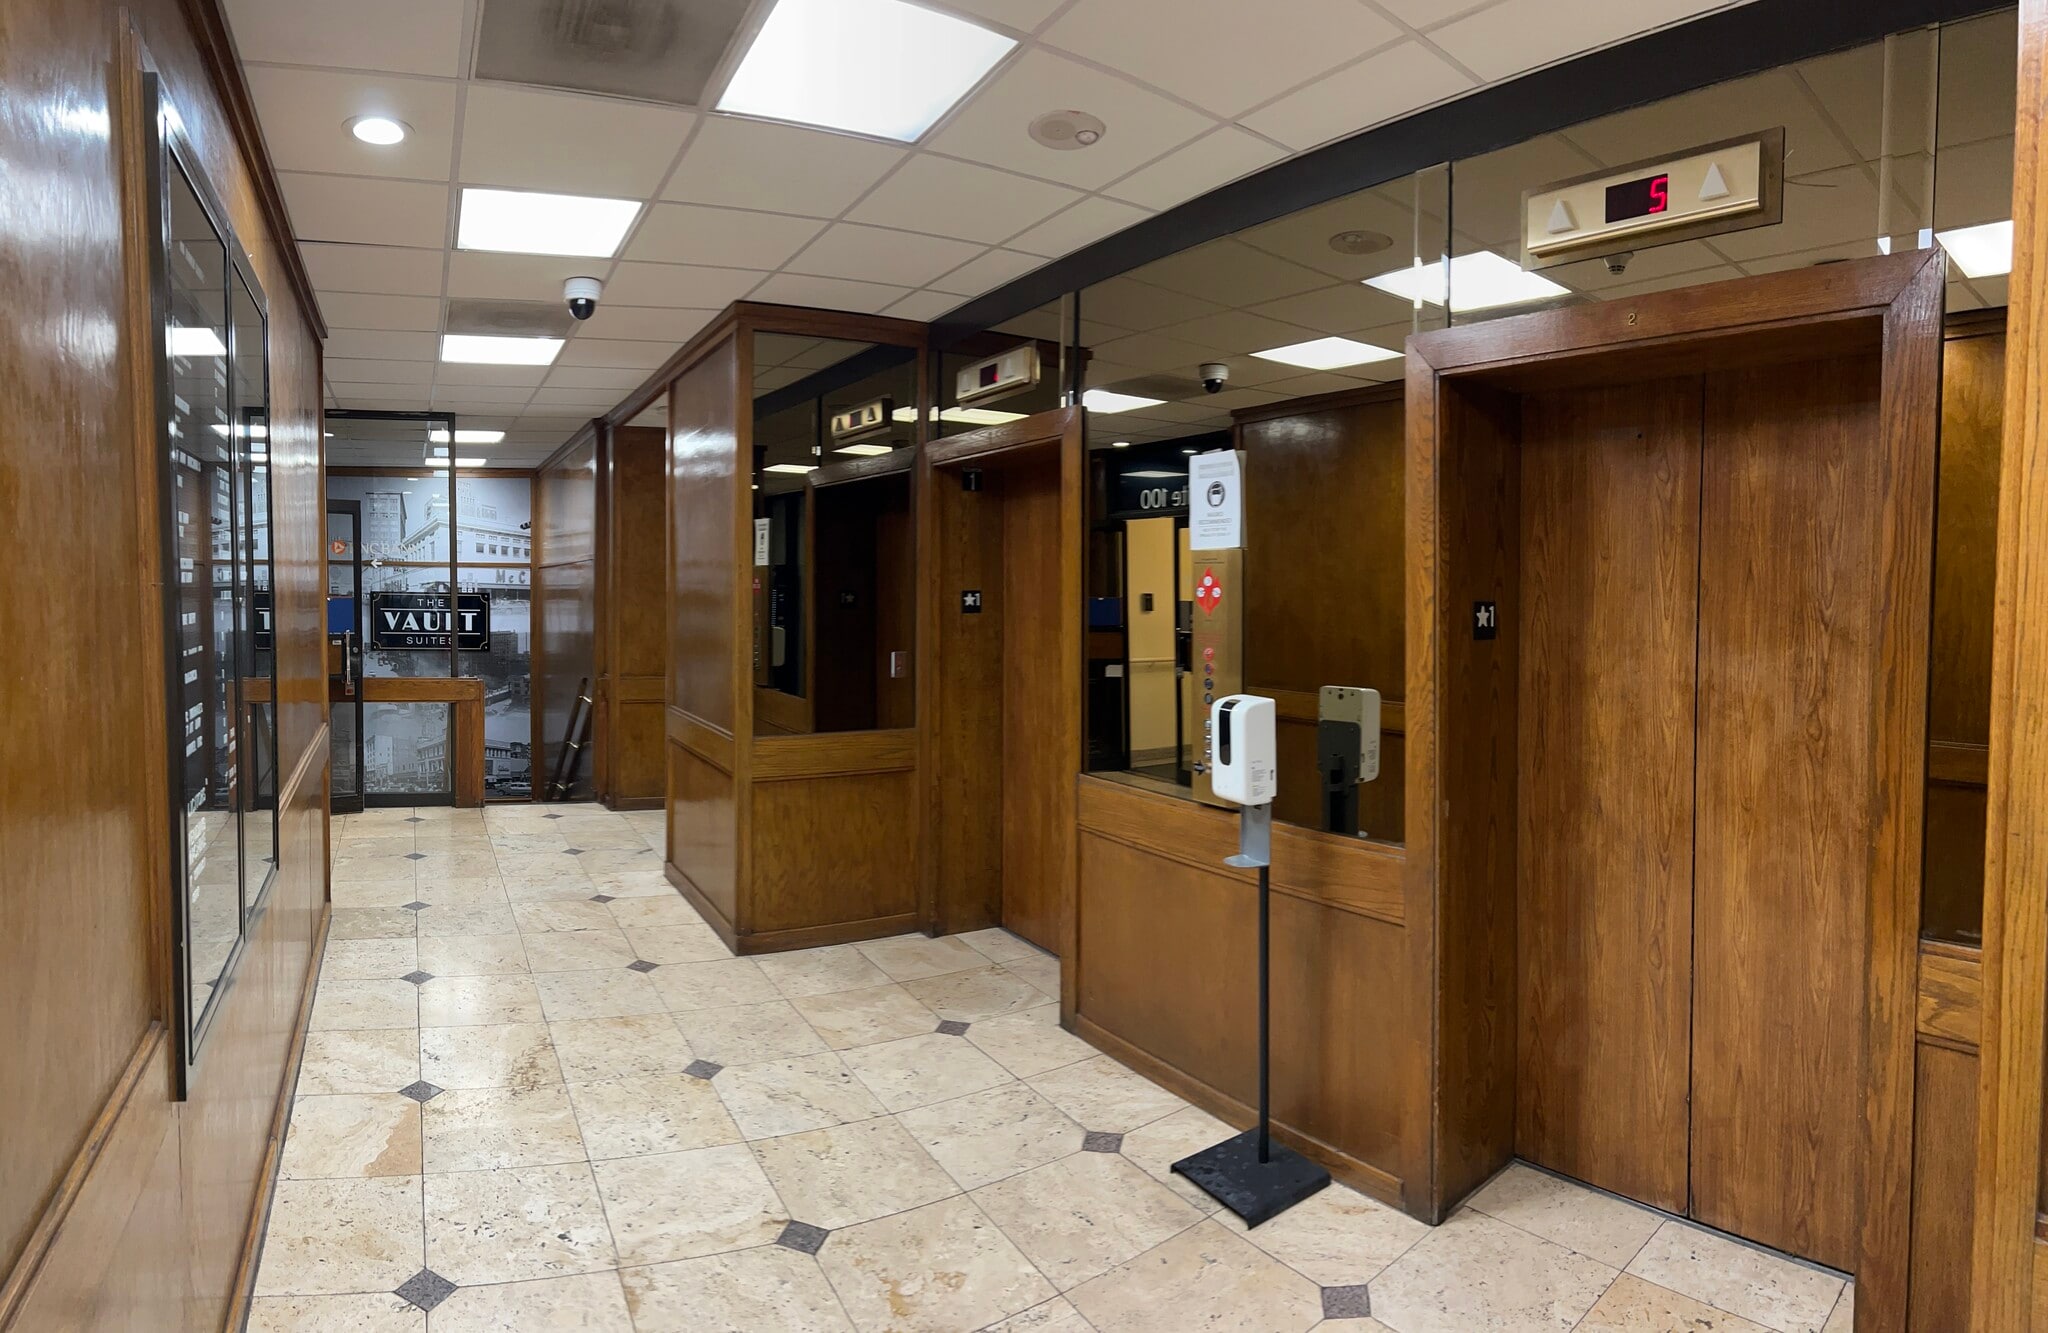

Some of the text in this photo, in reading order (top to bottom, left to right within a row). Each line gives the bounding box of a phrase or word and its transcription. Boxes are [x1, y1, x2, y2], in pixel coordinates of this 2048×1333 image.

[1649, 177, 1668, 213] 5
[1628, 312, 1637, 326] 2
[417, 598, 445, 608] THE
[384, 611, 478, 631] VAULT
